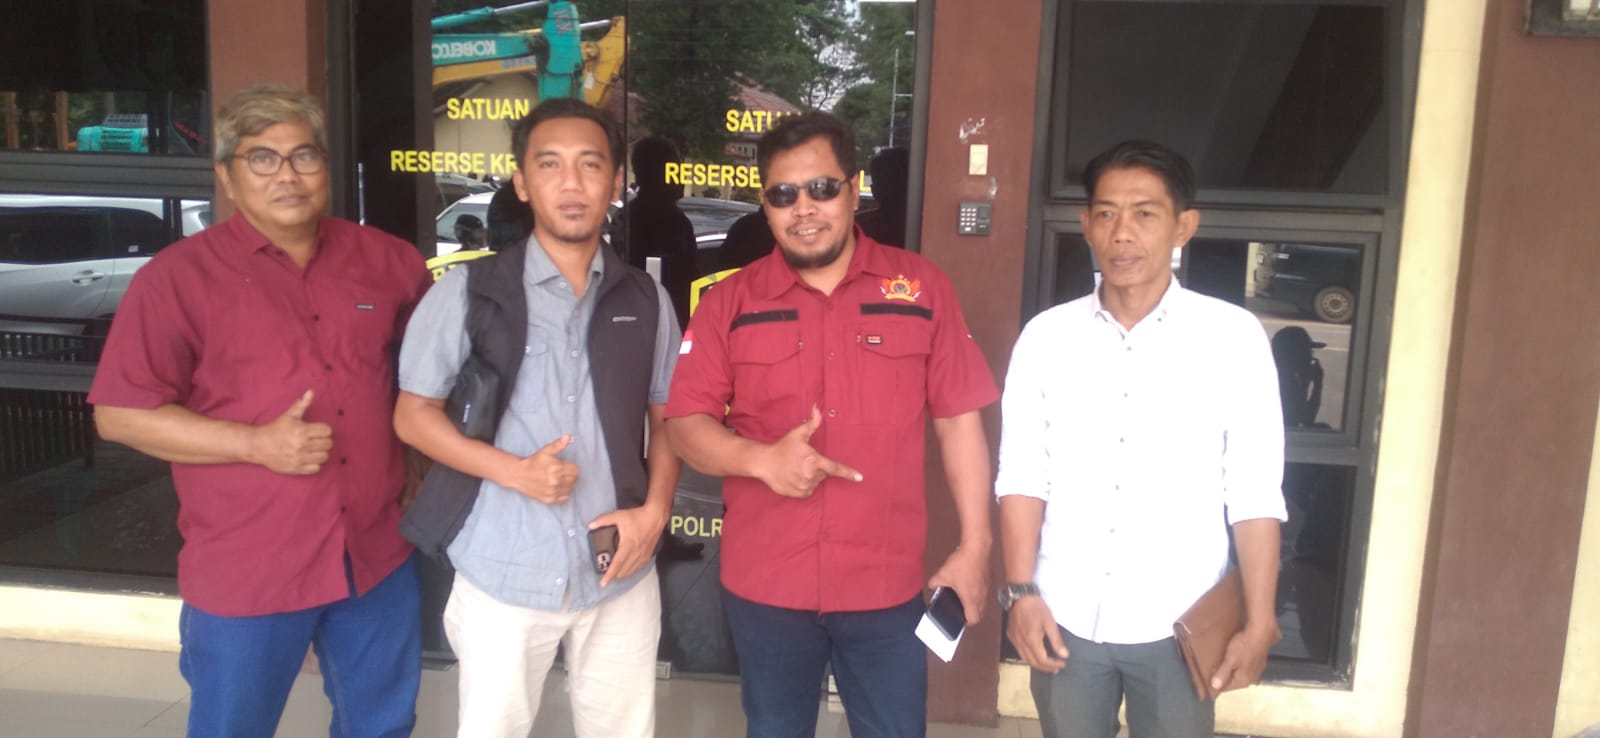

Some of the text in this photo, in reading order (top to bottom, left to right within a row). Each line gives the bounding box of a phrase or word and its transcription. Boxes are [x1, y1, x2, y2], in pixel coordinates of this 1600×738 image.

[447, 98, 529, 120] SATUAN
[726, 109, 802, 133] SATU
[390, 150, 518, 175] RESERSE KR
[665, 162, 762, 188] RESERSE
[671, 515, 723, 537] POLR
